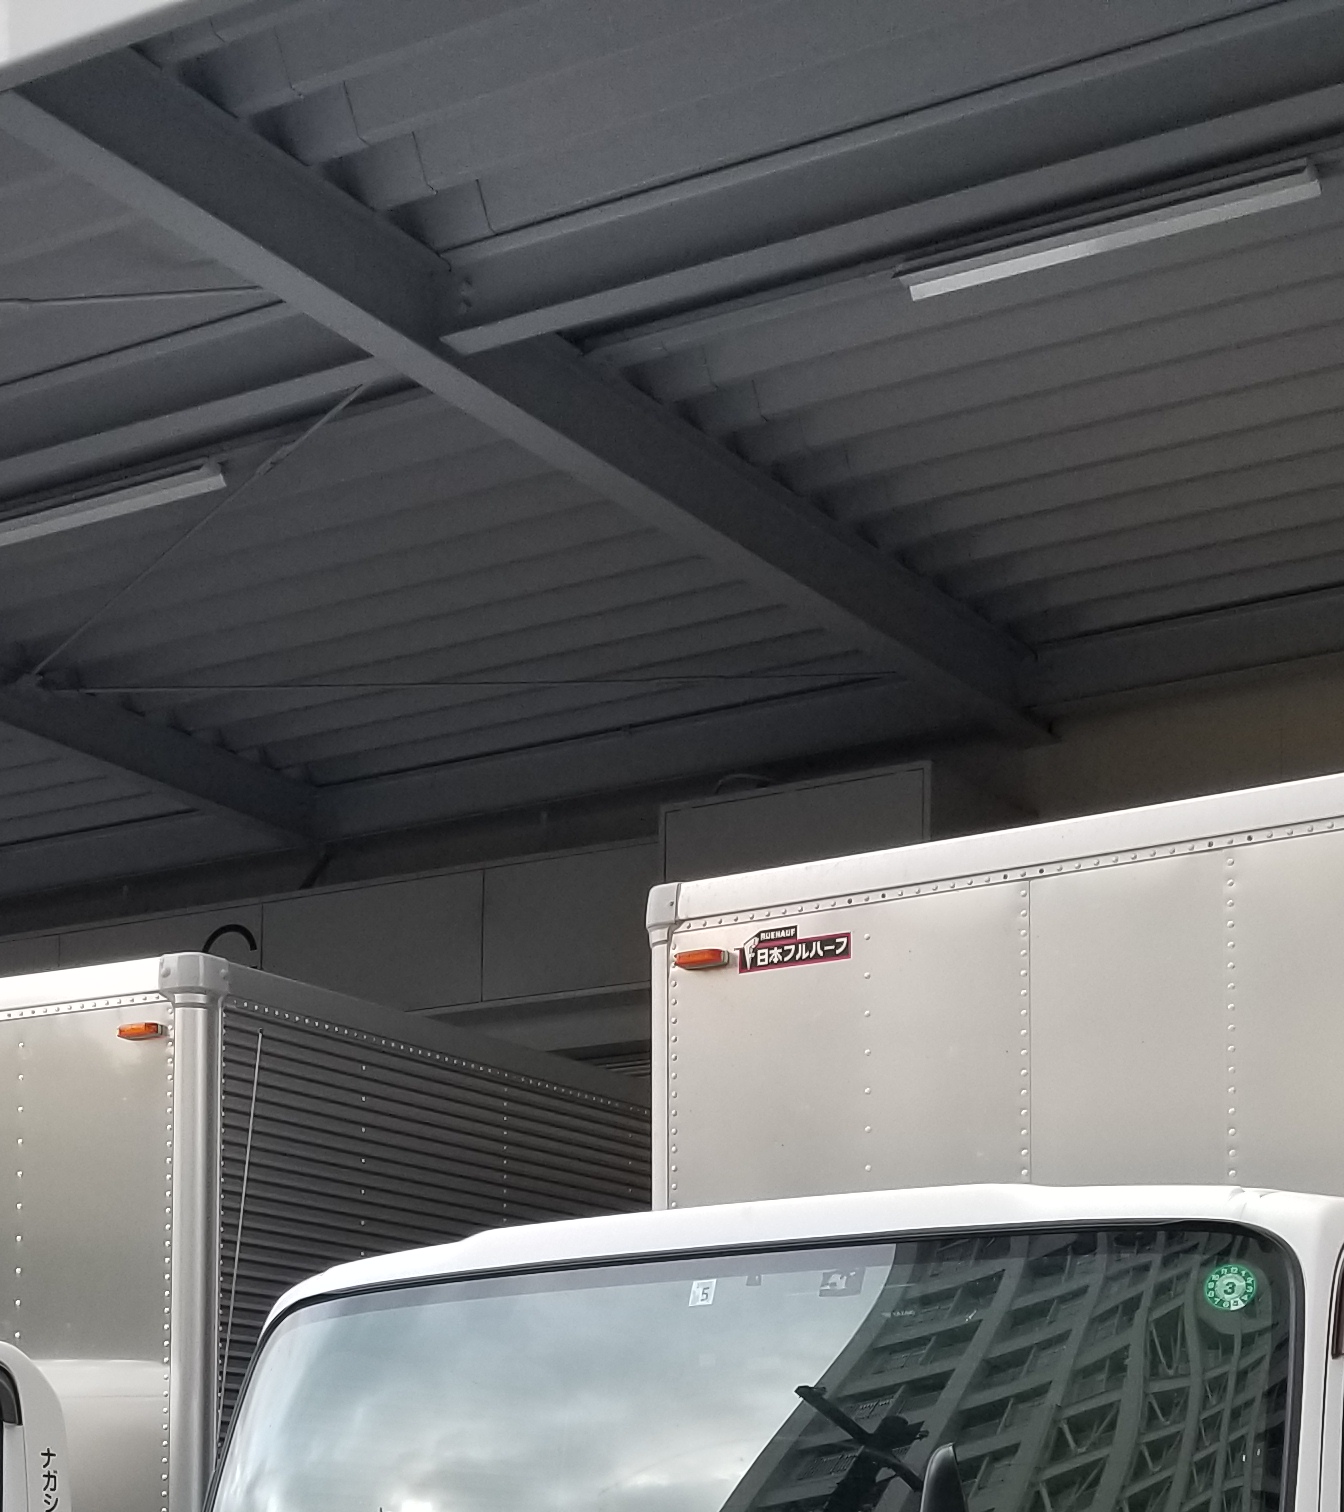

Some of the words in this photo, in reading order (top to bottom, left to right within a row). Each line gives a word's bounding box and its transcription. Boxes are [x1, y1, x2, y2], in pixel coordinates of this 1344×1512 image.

[757, 936, 848, 967] 日本フルハーフ
[700, 1286, 710, 1301] 5
[1223, 1281, 1236, 1295] 3
